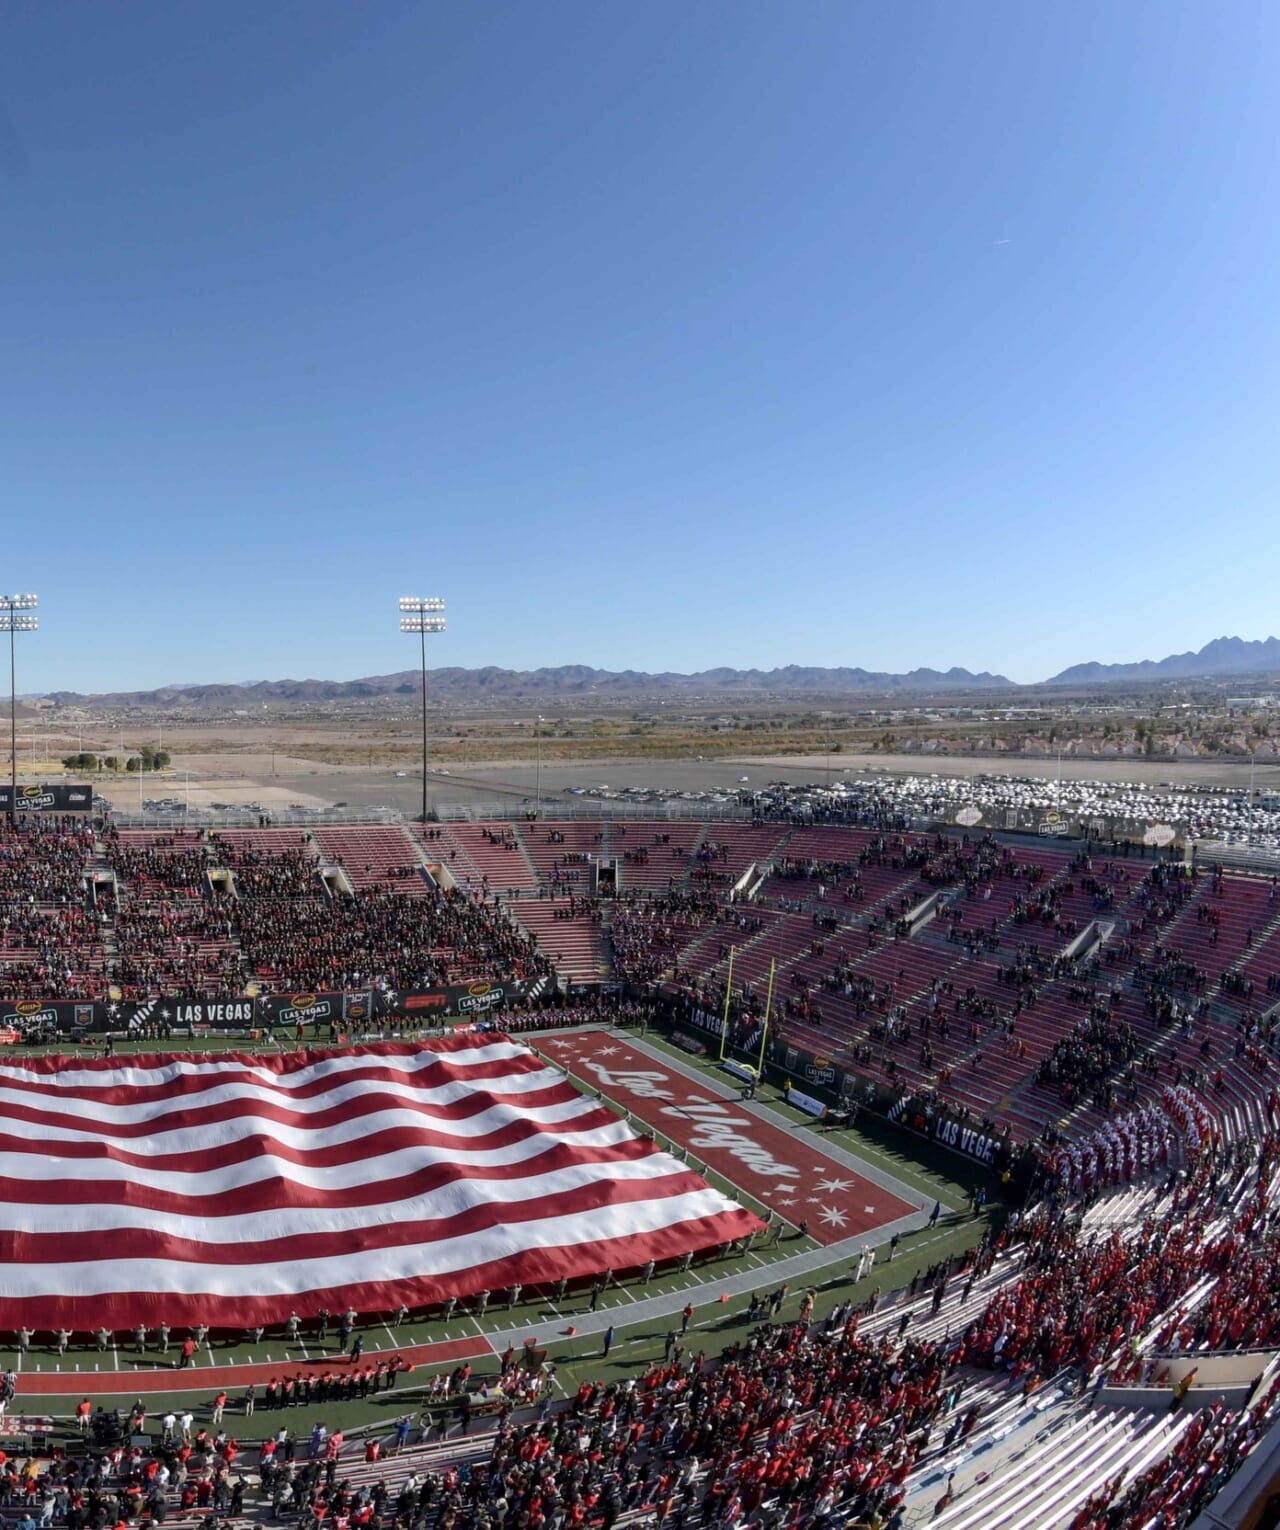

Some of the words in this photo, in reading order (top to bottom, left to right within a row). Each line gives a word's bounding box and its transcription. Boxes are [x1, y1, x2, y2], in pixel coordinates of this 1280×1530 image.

[405, 994, 447, 1008] ESPN
[463, 1000, 476, 1008] LAS
[476, 992, 500, 1004] VEGAS
[9, 1017, 24, 1025] LAS
[25, 1013, 53, 1023] VEGAS
[176, 1005, 202, 1022] LAS
[207, 1003, 252, 1021] VEGAS
[285, 1012, 299, 1020] LAS
[300, 1005, 326, 1016] VEGAS
[691, 1008, 705, 1026] LAS
[584, 1062, 677, 1100] Las
[659, 1095, 801, 1178] Vegas
[936, 1118, 960, 1146] LAS
